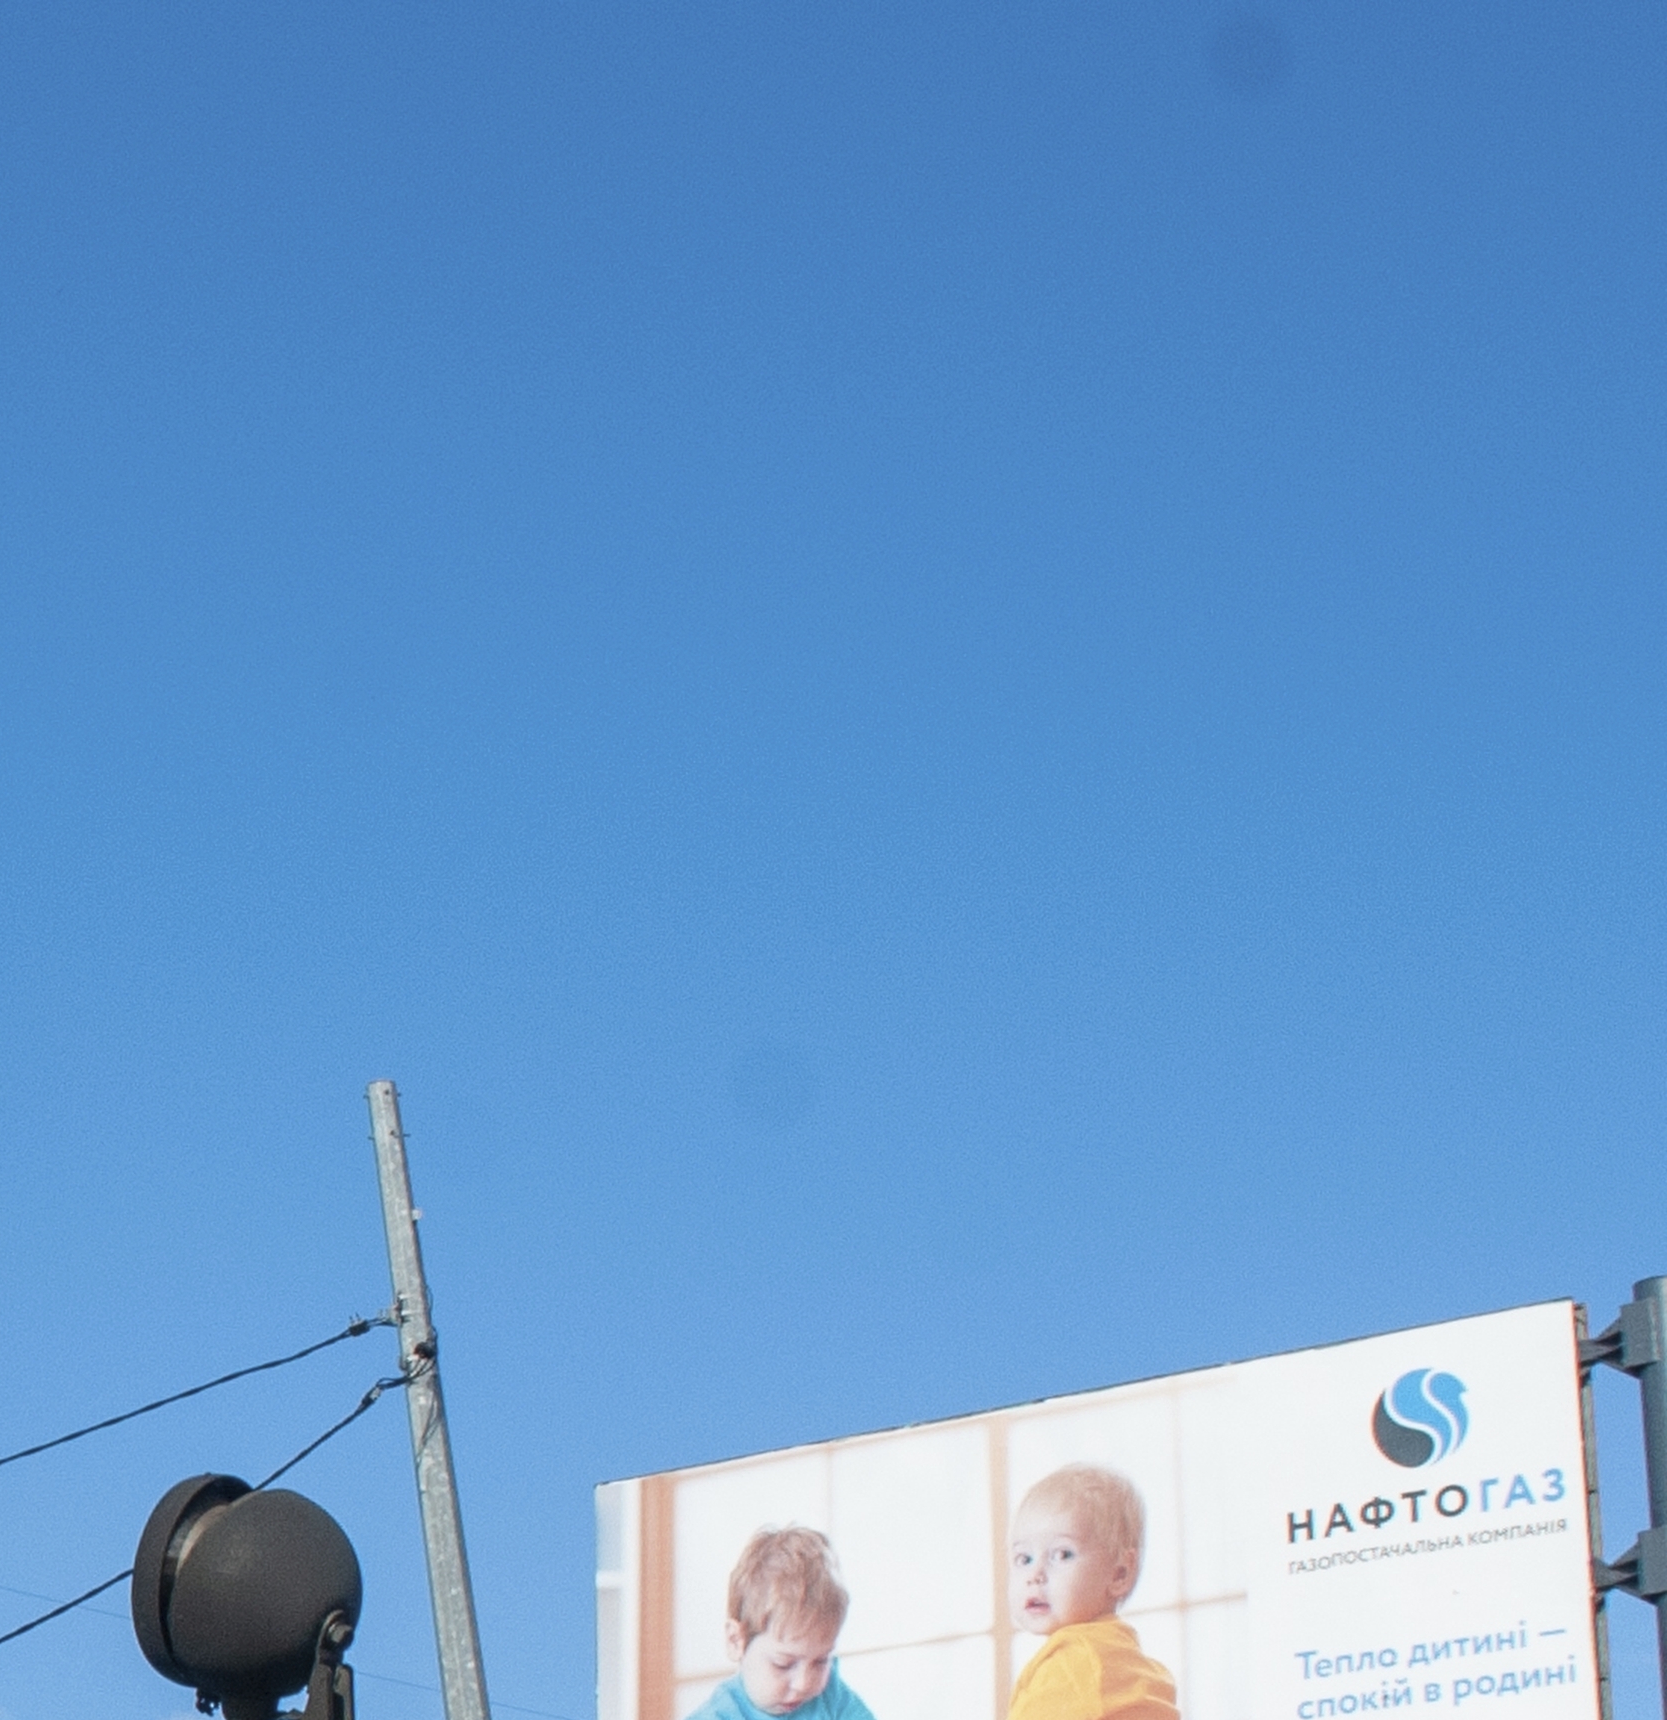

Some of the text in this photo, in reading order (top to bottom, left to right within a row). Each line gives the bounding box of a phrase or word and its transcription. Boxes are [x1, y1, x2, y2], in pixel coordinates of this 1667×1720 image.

[1287, 1468, 1565, 1543] НАФТОГАЗ
[1288, 1518, 1567, 1575] ГАЗОПОСТАЧАЛЬНА КОМПАНІЯ
[1295, 1649, 1398, 1680] Тепло
[1408, 1620, 1528, 1668] дитині
[1297, 1654, 1577, 1720] спокій в родині
